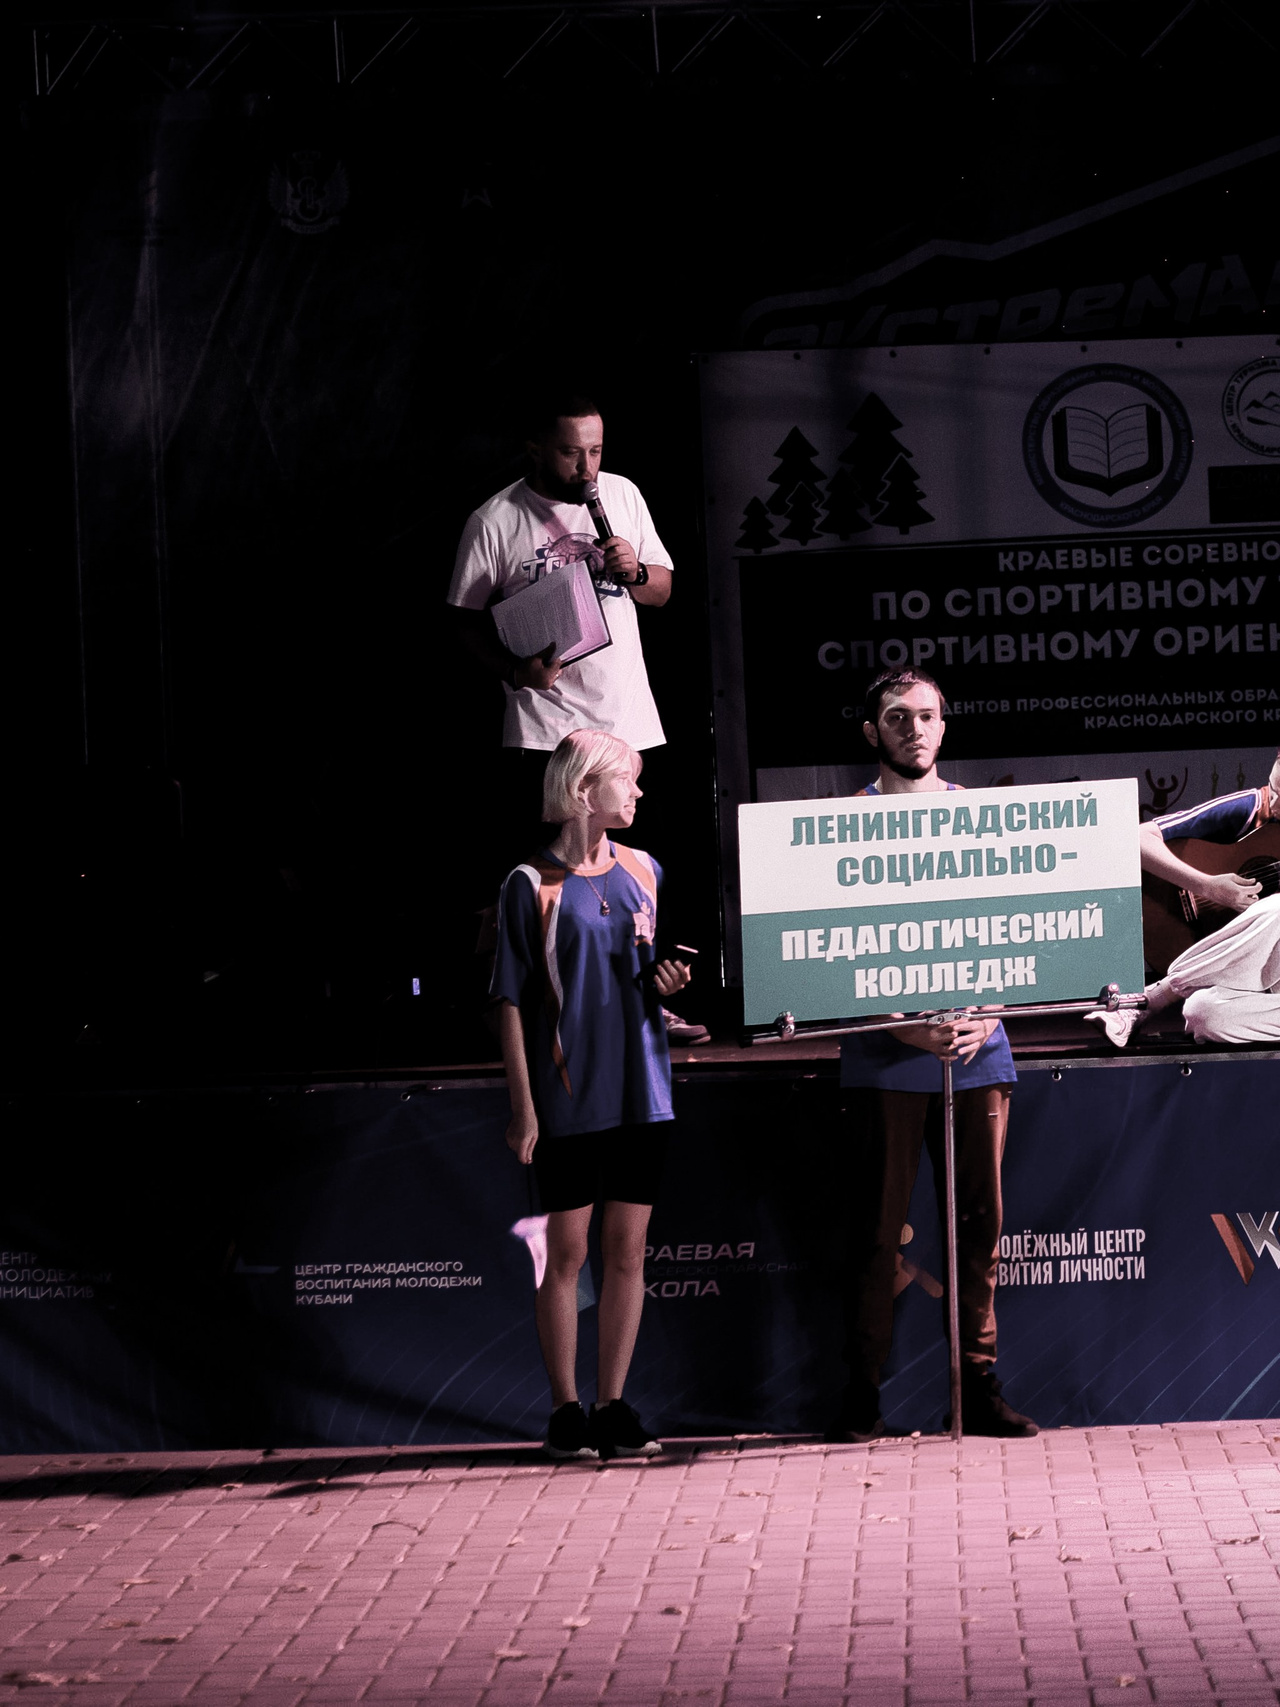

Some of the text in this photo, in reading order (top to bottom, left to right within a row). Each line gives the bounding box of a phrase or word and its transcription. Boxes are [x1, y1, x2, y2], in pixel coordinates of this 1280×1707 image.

[1226, 384, 1238, 416] ЦЕНТР
[1233, 360, 1278, 384] ТУРИЗМА
[998, 545, 1134, 573] КРАЕВЫЕ
[871, 589, 931, 621] ПО
[944, 575, 1267, 619] СПОРТИВНОМУ
[817, 629, 1142, 671] СПОРТИВНОМУ
[941, 699, 1011, 717] ДЕНТОВ
[1016, 689, 1228, 713] ПРОФЕССИОНАЛЬНЫХ
[1084, 709, 1259, 730] КРАСНОДАРСКОГО
[790, 792, 1099, 846] ЛЕНИНГРАДСКИЙ
[836, 843, 1078, 887] СОЦИАЛЬНО-
[781, 902, 1103, 962] ПЕДАГОГИЧЕСКИЙ
[854, 955, 1037, 999] КОЛЛЕДЖ
[645, 1242, 756, 1262] РАЕВАЯ
[1000, 1227, 1146, 1261] ОДЁЖНЫЙ ЦЕНТР
[0, 1251, 39, 1266] ЕНТР
[294, 1260, 465, 1278] ЦЕНТР ГРАЖДАНСКОГО
[998, 1256, 1145, 1286] ВИТИЯ ЛИЧНОСТИ
[0, 1285, 95, 1300] НИЦИАТИВ
[295, 1275, 483, 1291] ВОСПИТАНИЯ МОЛОДЕЖИ
[645, 1280, 721, 1298] КОЛА
[295, 1293, 353, 1306] КУБАНИ
